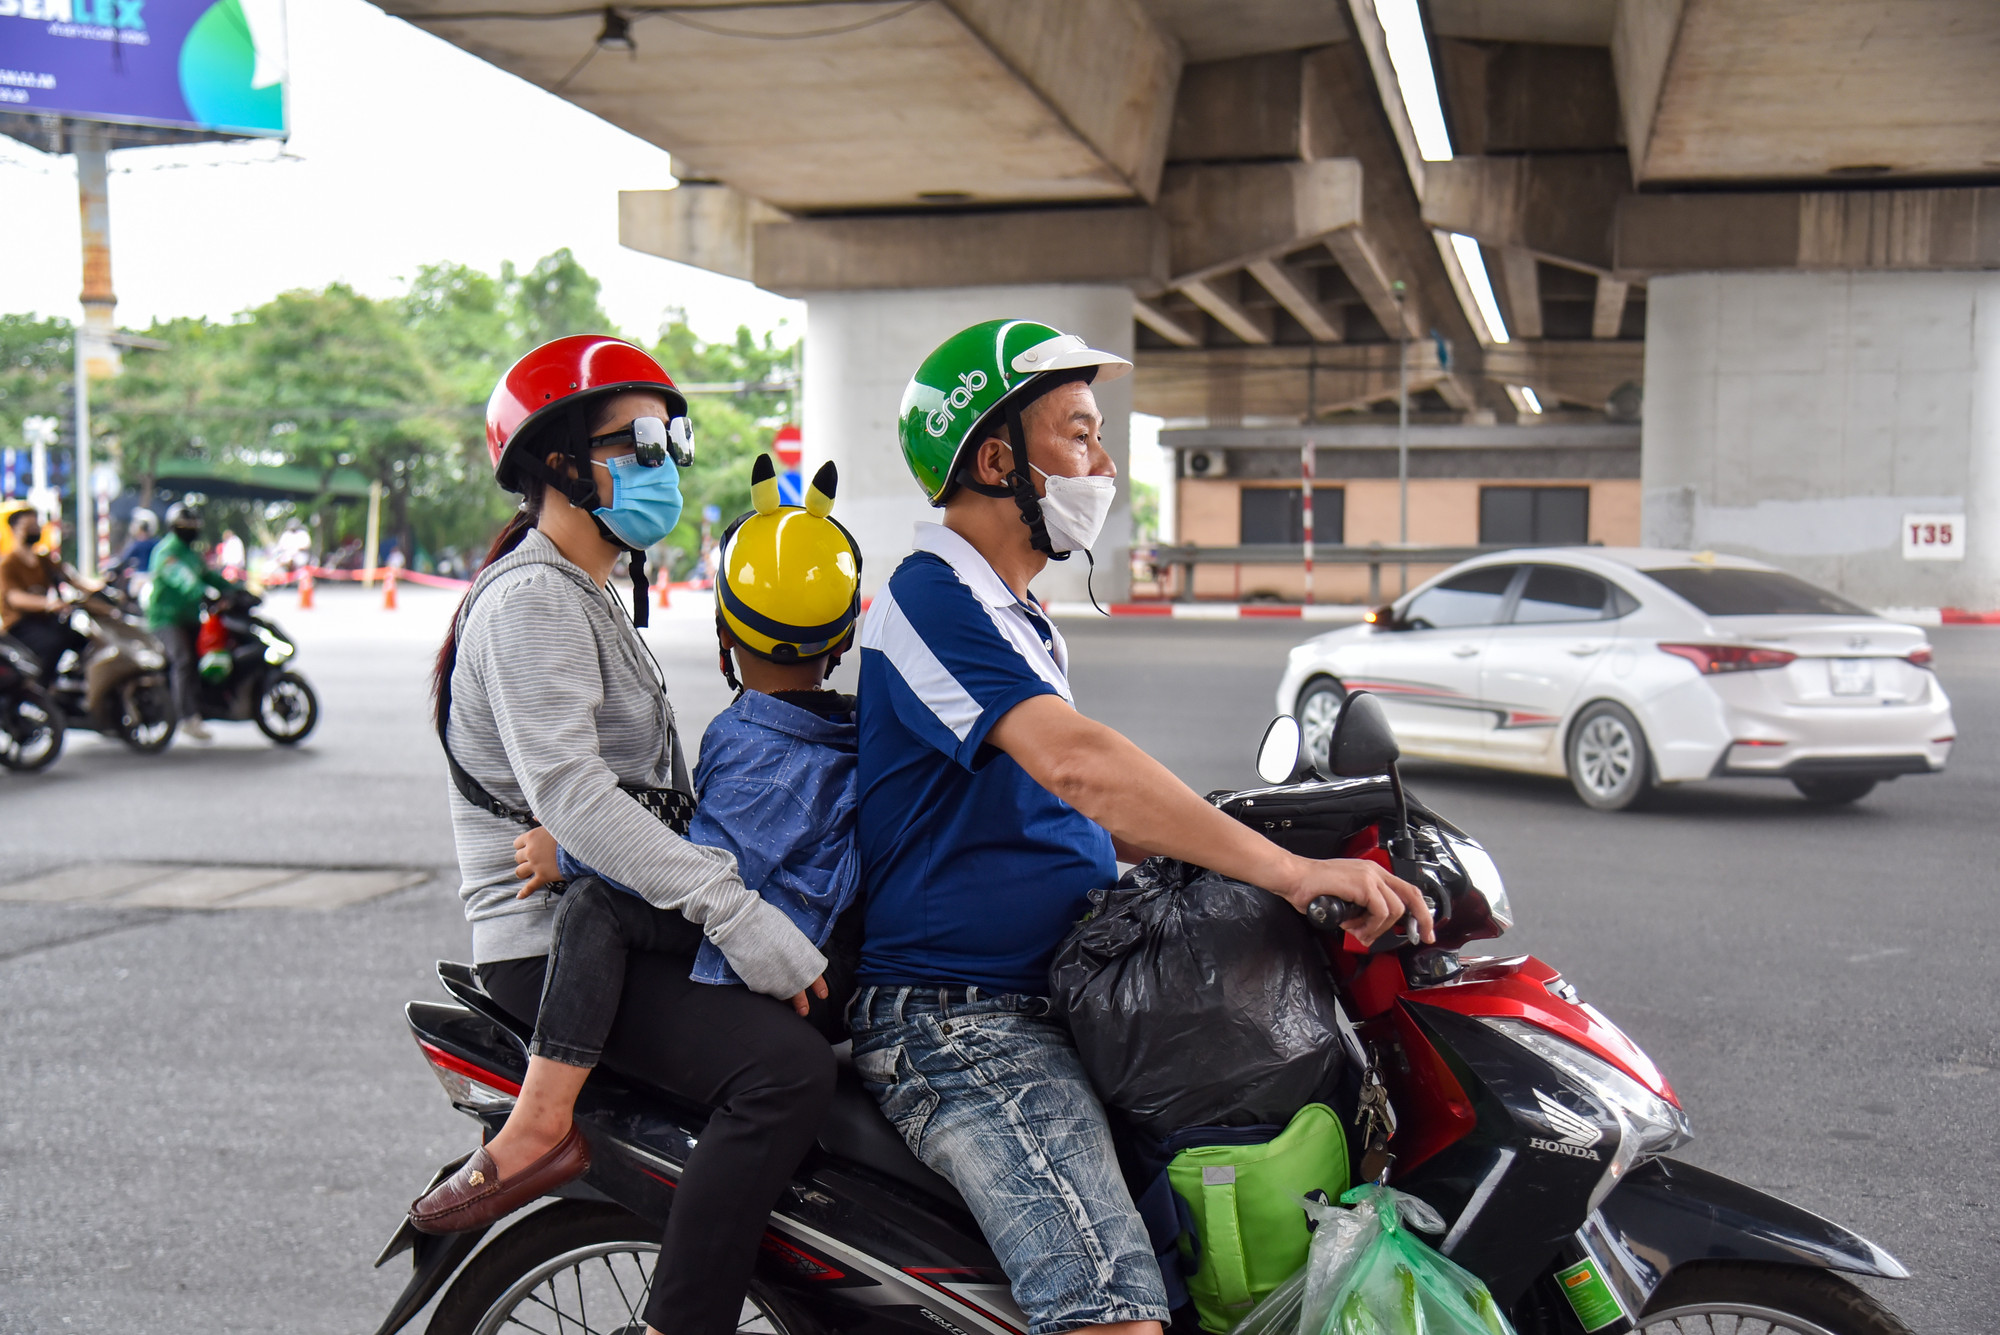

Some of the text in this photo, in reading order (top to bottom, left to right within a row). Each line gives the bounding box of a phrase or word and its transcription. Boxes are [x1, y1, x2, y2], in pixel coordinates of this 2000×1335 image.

[926, 370, 988, 437] Grab
[1910, 523, 1952, 545] T35
[1529, 1137, 1601, 1161] HONDA
